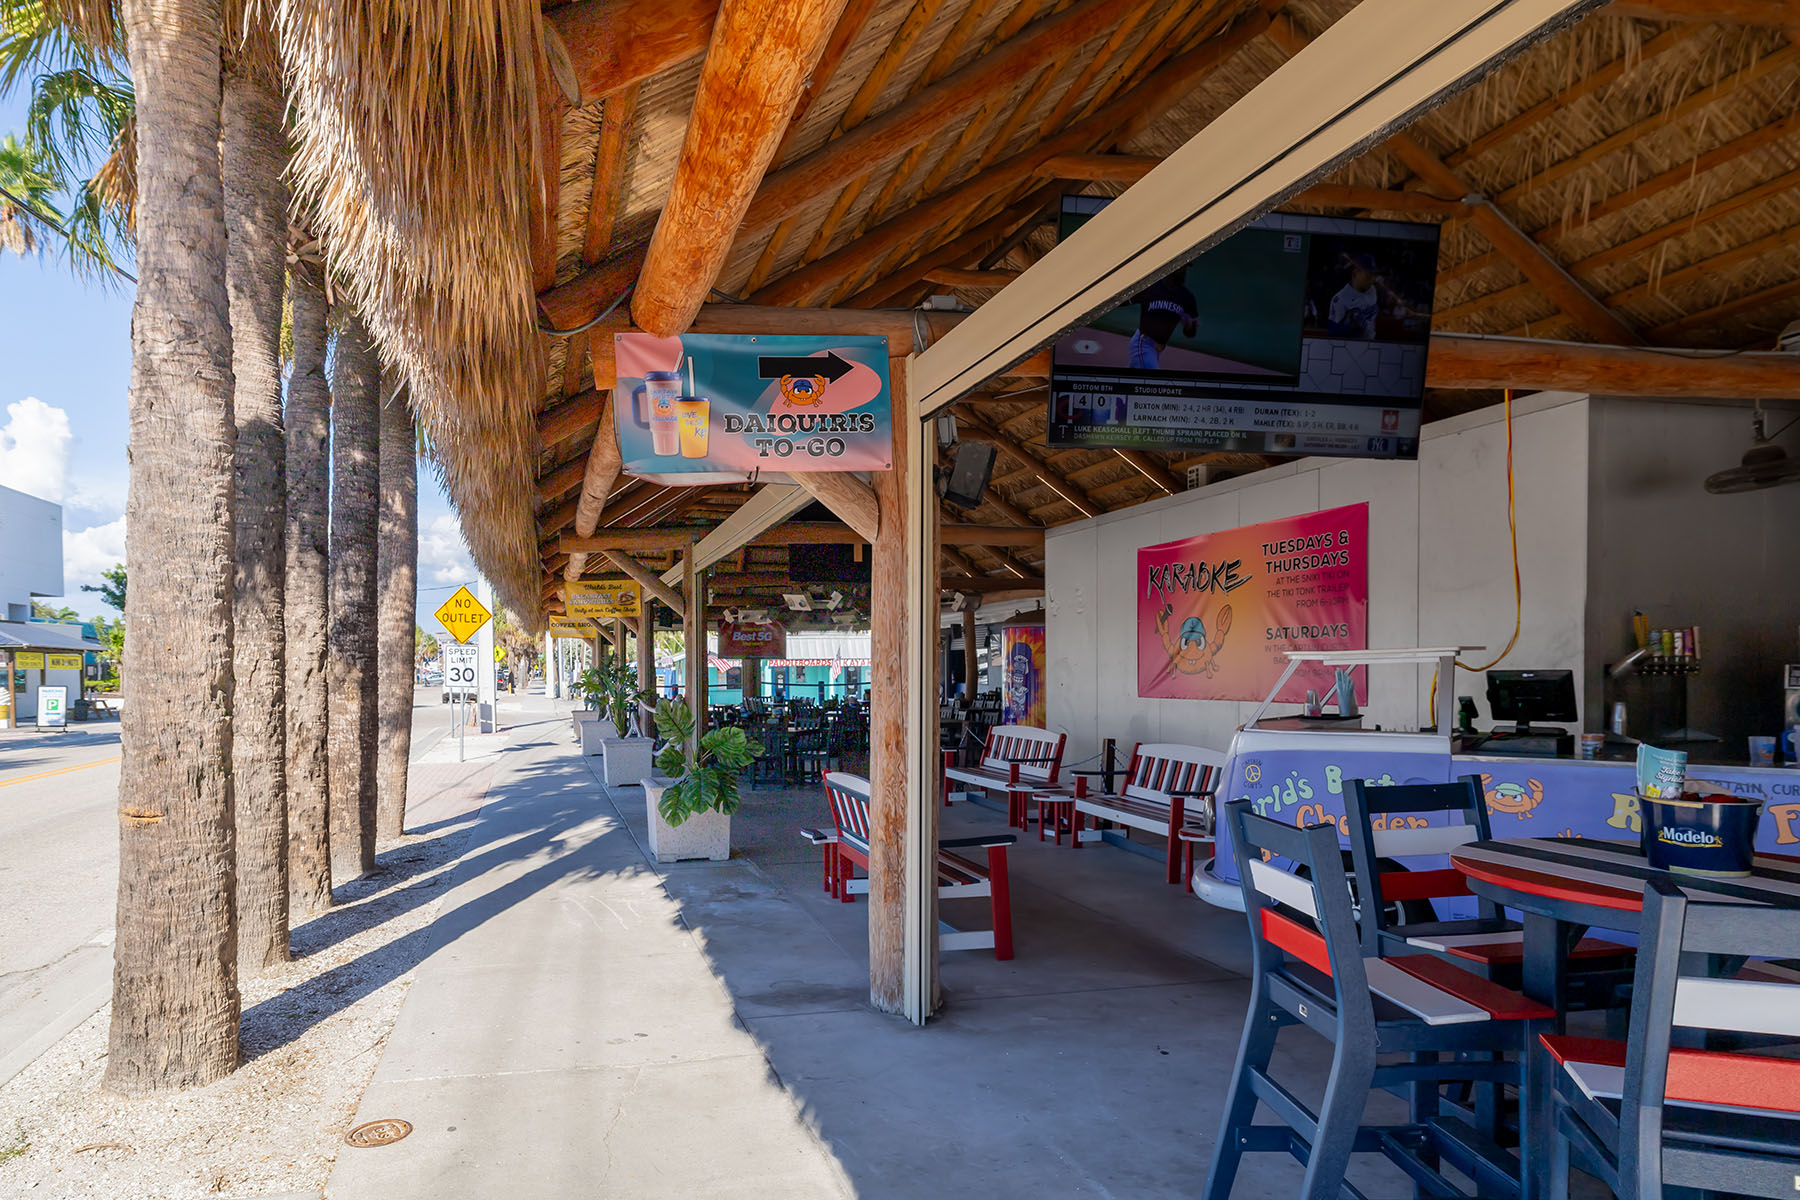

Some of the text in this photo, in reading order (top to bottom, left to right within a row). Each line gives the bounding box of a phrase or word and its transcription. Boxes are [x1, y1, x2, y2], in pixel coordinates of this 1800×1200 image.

[1072, 383, 1099, 391] BOTTOM
[1134, 386, 1183, 395] STUDIO UPDATE
[1078, 396, 1087, 406] 4
[1097, 396, 1106, 407] 0
[1133, 402, 1160, 410] BUXTON
[1254, 407, 1279, 416] DURAN
[724, 413, 875, 433] DAIQUIRIS
[1133, 414, 1167, 422] LARNACH
[1253, 419, 1275, 427] MAHLE
[1074, 425, 1091, 433] LUKE
[1093, 426, 1131, 434] KEASCHALL
[1151, 428, 1175, 436] THUMB
[755, 438, 845, 457] TO-GO
[1262, 530, 1348, 556] TUESDAYS &
[1265, 550, 1349, 574] THURSDAYS
[1147, 559, 1252, 604] KARAOKE
[1275, 576, 1286, 585] AT
[1286, 575, 1300, 584] THE
[1267, 589, 1280, 598] THE
[1282, 588, 1294, 597] TIKI
[1295, 586, 1316, 595] TONK
[455, 599, 471, 609] NO
[1296, 599, 1319, 608] FROM
[442, 613, 484, 623] OUTLET
[732, 631, 773, 641] Best 5G
[1265, 624, 1349, 640] SATURDAYS
[448, 648, 477, 656] SPEED
[768, 659, 832, 667] PADDLEBOARDS
[450, 667, 475, 682] 30
[1662, 826, 1714, 844] Modelo
